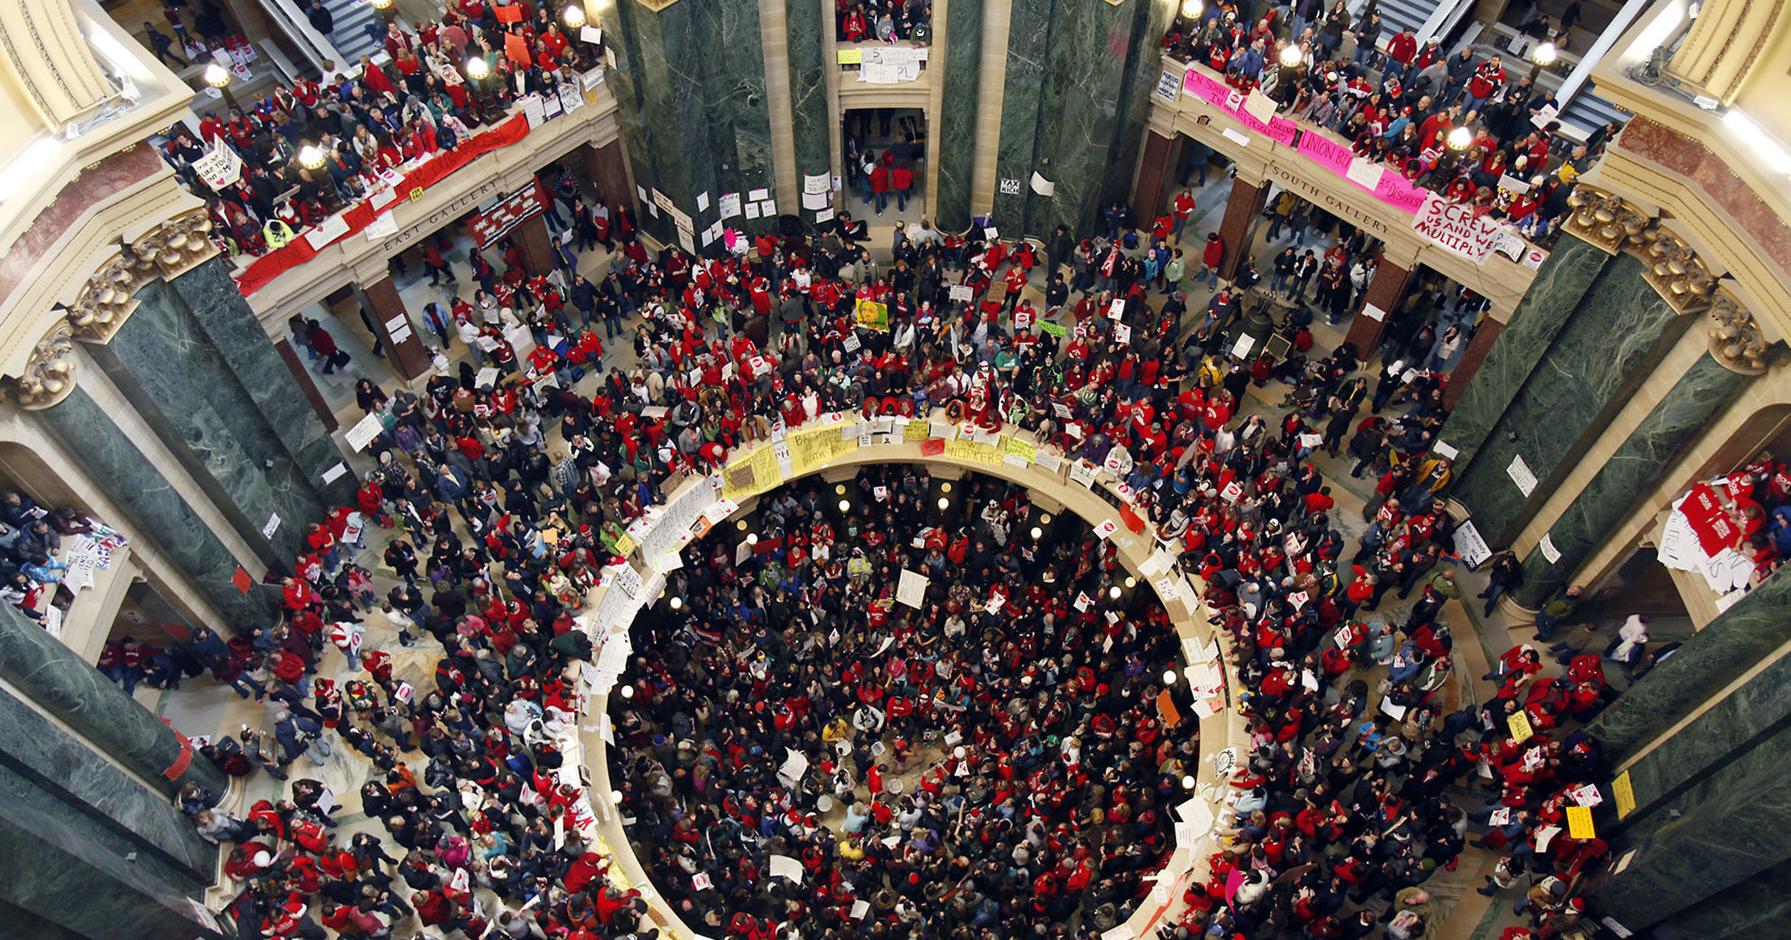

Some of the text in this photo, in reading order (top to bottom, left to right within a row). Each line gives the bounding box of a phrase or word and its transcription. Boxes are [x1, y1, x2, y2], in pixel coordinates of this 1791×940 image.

[1302, 129, 1335, 160] UNION
[384, 179, 498, 252] EAST GALLERY
[1272, 166, 1388, 234] SOUTH GALLERY
[1428, 199, 1497, 236] SCREW
[1414, 221, 1486, 257] MULTIPLY
[1426, 216, 1441, 227] US
[1443, 222, 1471, 239] AND
[1475, 234, 1494, 250] WE
[946, 446, 1004, 465] WORKERS
